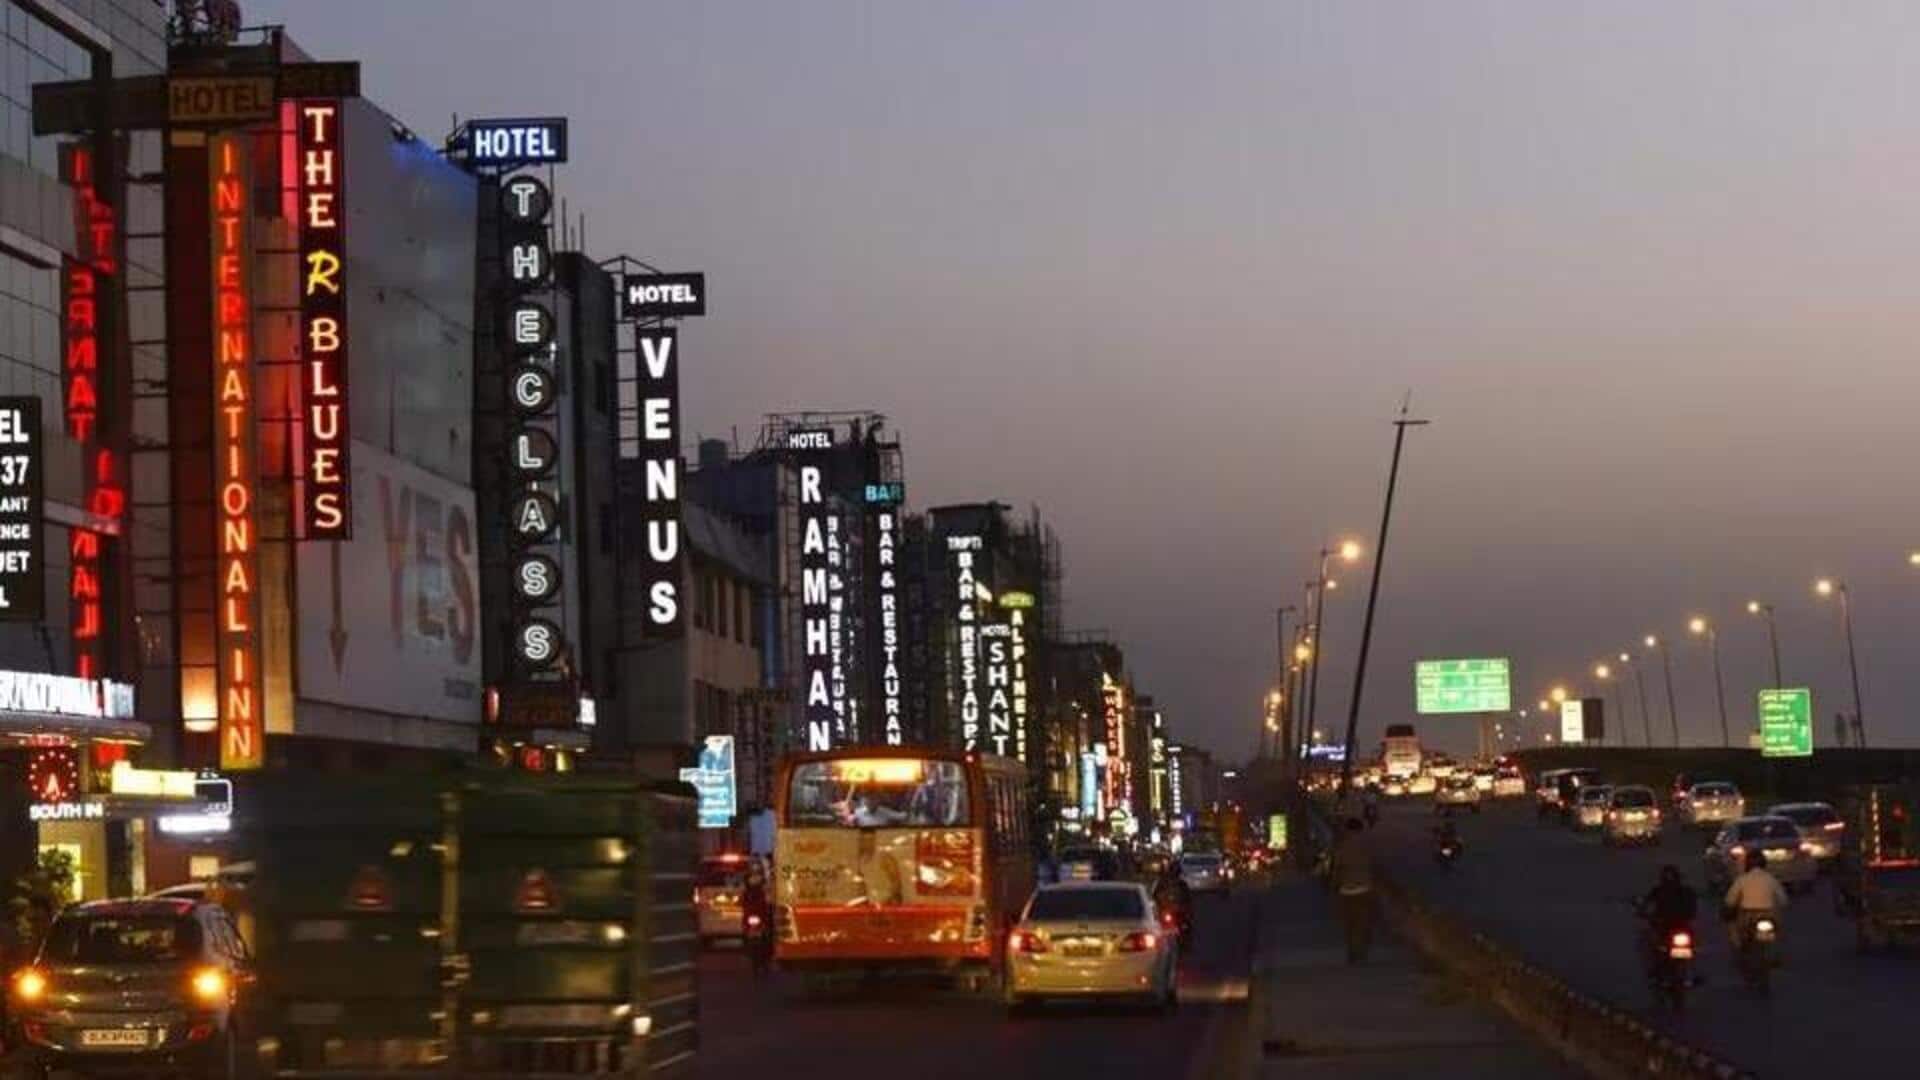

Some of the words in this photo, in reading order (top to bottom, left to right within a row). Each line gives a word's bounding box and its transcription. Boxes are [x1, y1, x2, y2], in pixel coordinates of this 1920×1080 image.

[172, 82, 270, 114] HOTEL
[475, 127, 556, 158] HOTEL
[304, 107, 336, 228] THE
[307, 249, 340, 295] R
[629, 284, 697, 304] HOTEL
[216, 143, 251, 632] INTERNATIONAL
[309, 317, 342, 528] BLUES
[789, 432, 832, 448] HOTEL
[640, 336, 679, 625] VENUS
[865, 484, 901, 501] BAR
[879, 514, 895, 565] BAR
[958, 551, 974, 600] BAR
[801, 466, 830, 752] RAMHAN
[224, 649, 251, 757] INN
[29, 803, 82, 820] SOUTH
